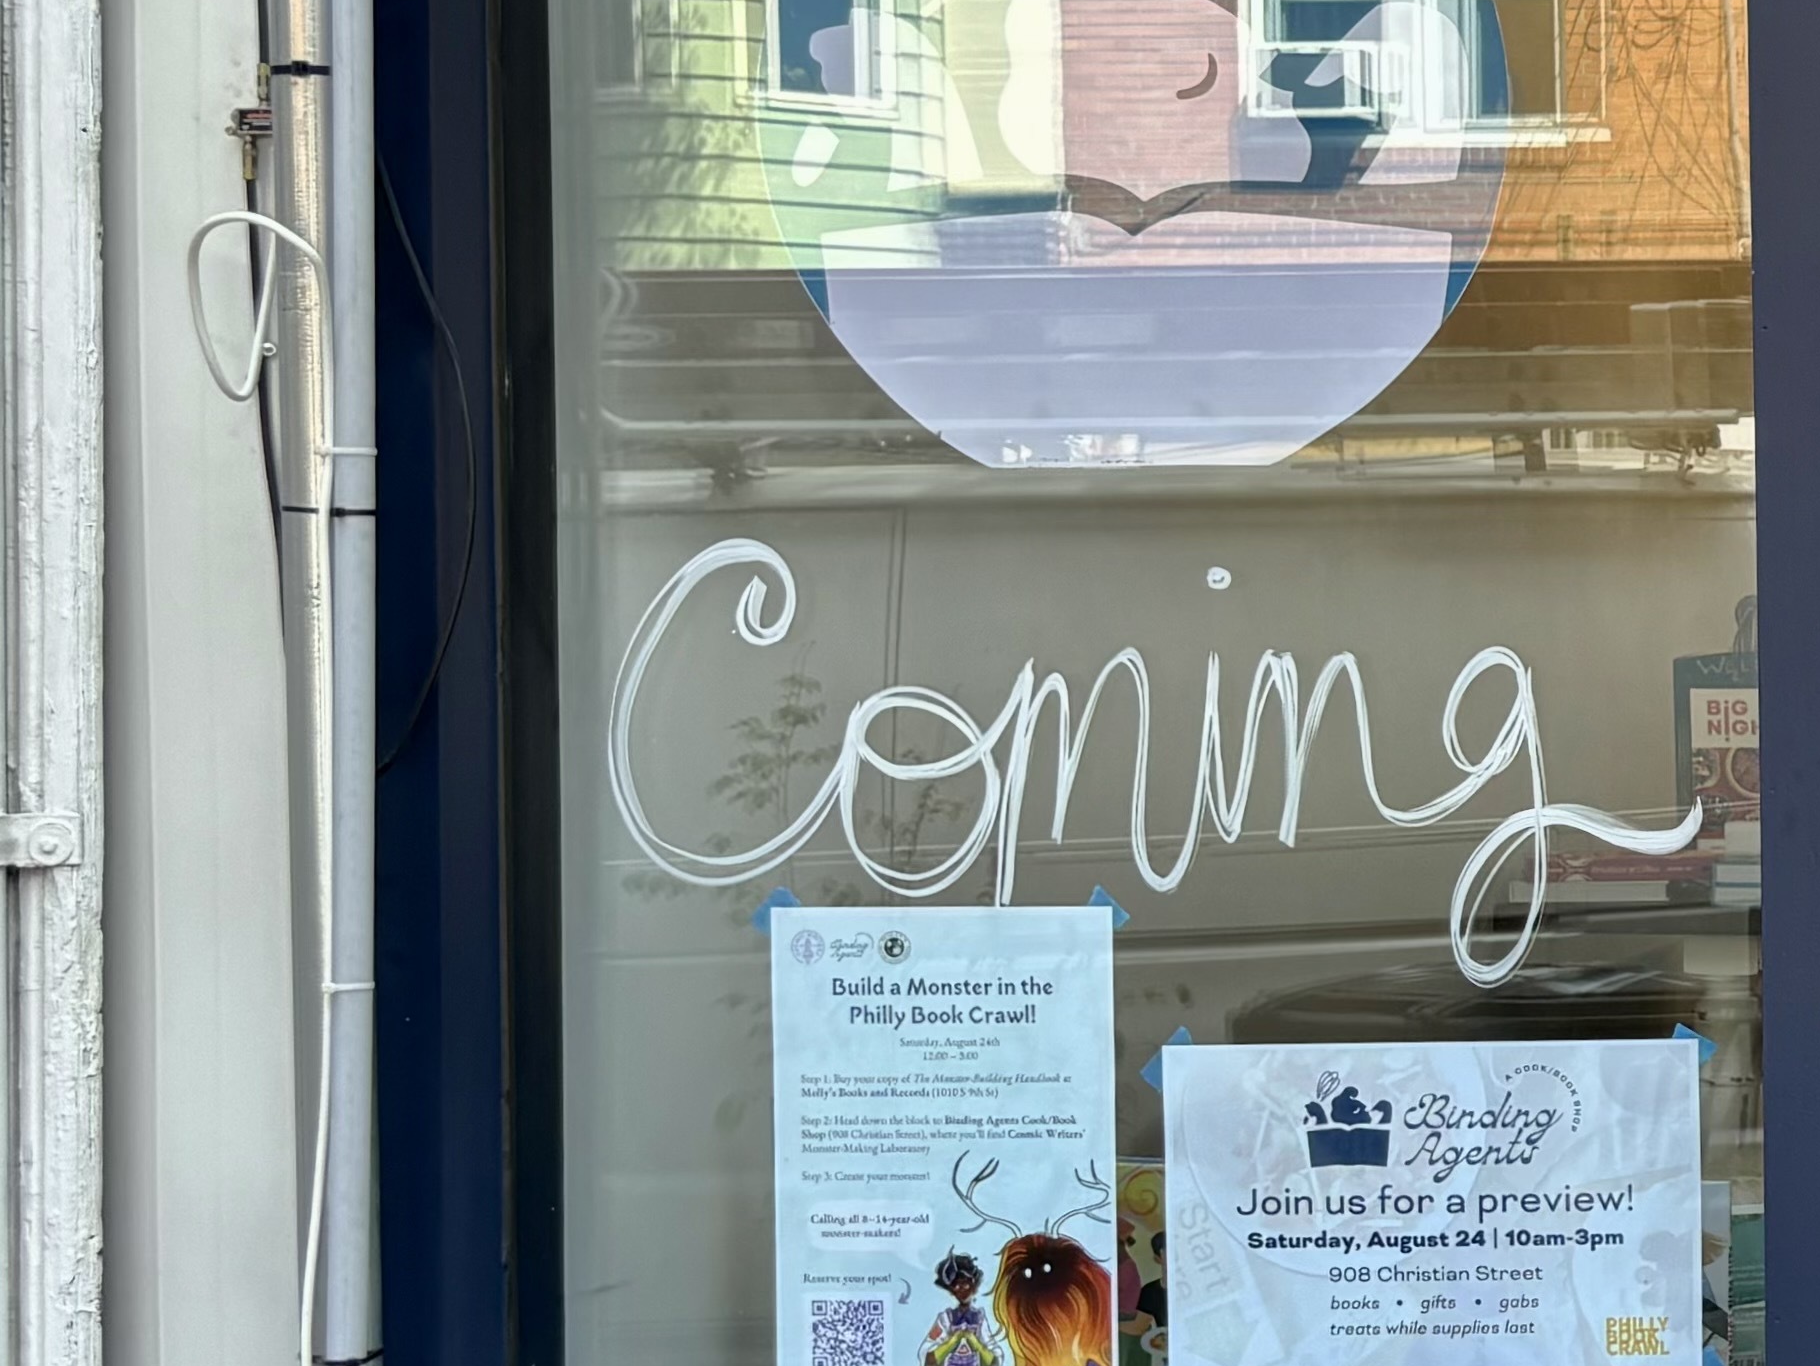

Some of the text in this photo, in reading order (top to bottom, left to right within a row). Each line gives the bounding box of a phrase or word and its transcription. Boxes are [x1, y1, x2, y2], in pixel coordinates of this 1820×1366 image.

[1707, 719, 1757, 736] NIG
[608, 535, 1704, 990] Coming
[831, 975, 1054, 997] Build a Monster in the
[849, 1003, 1037, 1032] Philly Book Crawl!
[1403, 1089, 1565, 1147] Binding
[1403, 1126, 1541, 1185] Agents
[1236, 1183, 1634, 1225] Join us for a preview!
[1247, 1228, 1625, 1255] Saturday, August 24 10am-3pm
[1328, 1263, 1544, 1284] 908 Christian Street
[1330, 1293, 1540, 1315] books gifts gabs
[1329, 1318, 1535, 1340] treats while supplies last
[1605, 1316, 1669, 1332] PHILLY
